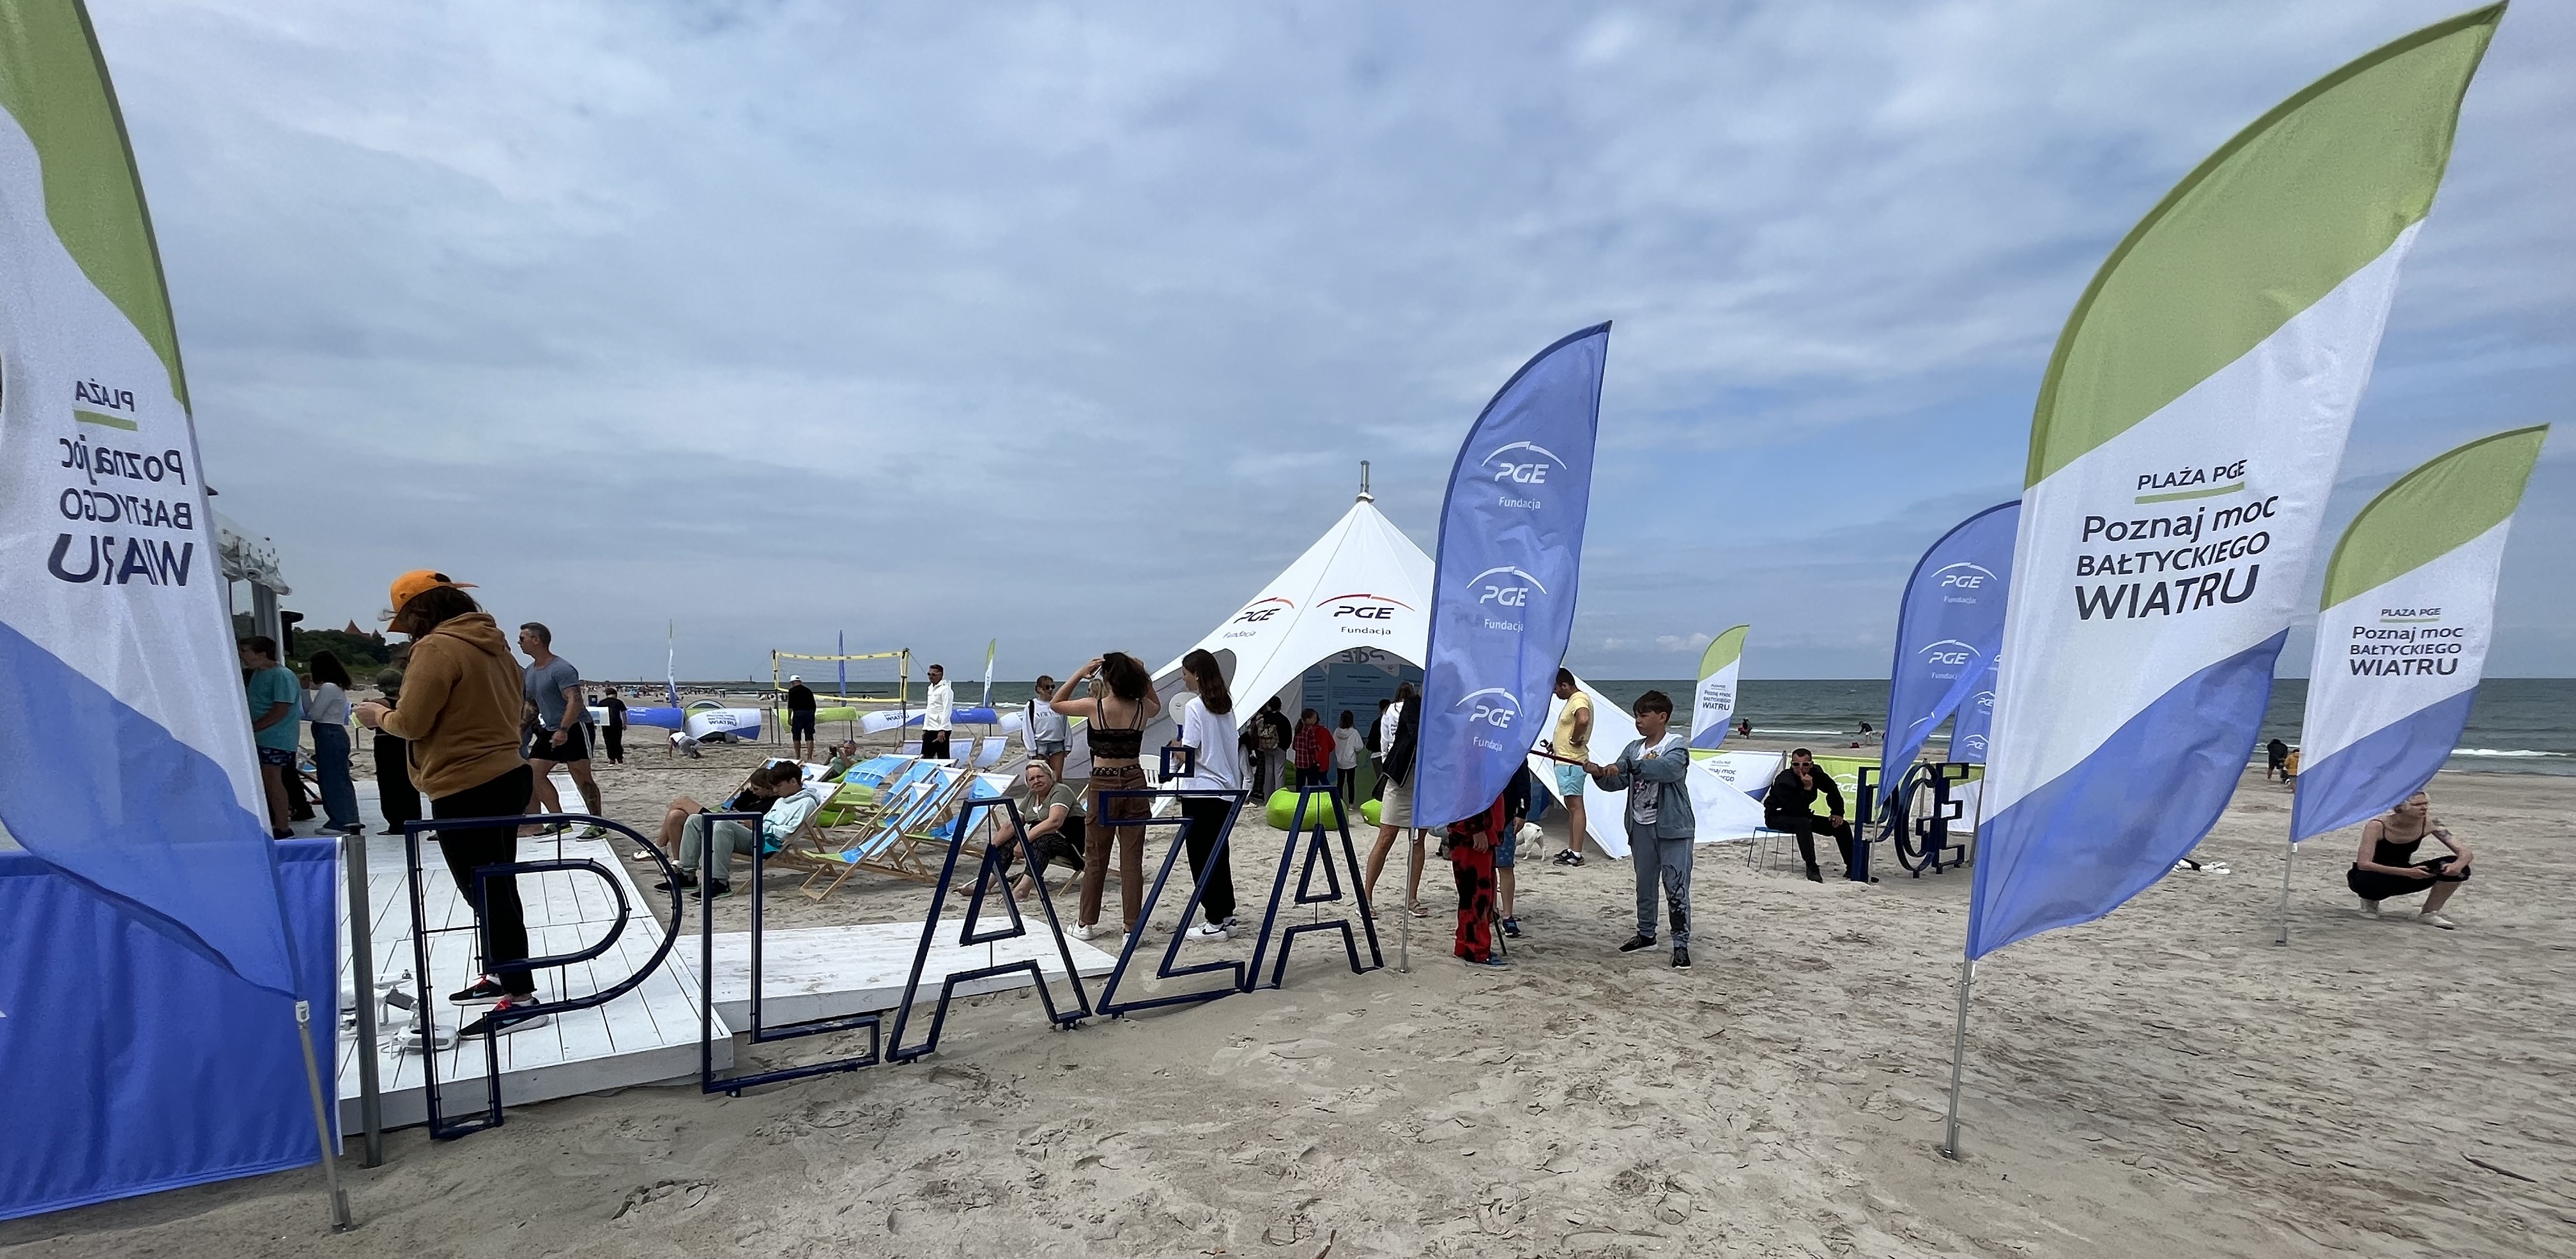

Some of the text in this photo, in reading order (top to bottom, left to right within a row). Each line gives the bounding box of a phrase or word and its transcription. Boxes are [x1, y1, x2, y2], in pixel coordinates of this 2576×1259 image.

[1494, 462, 1549, 484] PGE
[2137, 459, 2248, 490] PLAŻA PGE
[1499, 496, 1541, 511] Fundacja
[2082, 496, 2279, 543] Poznaj moc
[2076, 531, 2270, 576] BAŁTYCKIEGO
[1941, 575, 1984, 589] PGE
[1479, 585, 1529, 607] PGE
[2074, 564, 2260, 620] WIATRU
[1233, 608, 1281, 624] PGE
[1333, 606, 1394, 620] PGE
[2419, 607, 2441, 616] PGE
[1341, 626, 1391, 636] Fundacja
[2352, 626, 2464, 643] Poznaj moc
[2350, 643, 2462, 655] BAŁTYCKIEGO
[1929, 652, 1970, 665] PGE
[2349, 658, 2458, 676] WIATRU
[1702, 701, 1730, 710] WIATRU
[1469, 705, 1515, 728] PGE
[1850, 763, 1970, 882] PGE
[402, 744, 1385, 1141] PLAŻA
